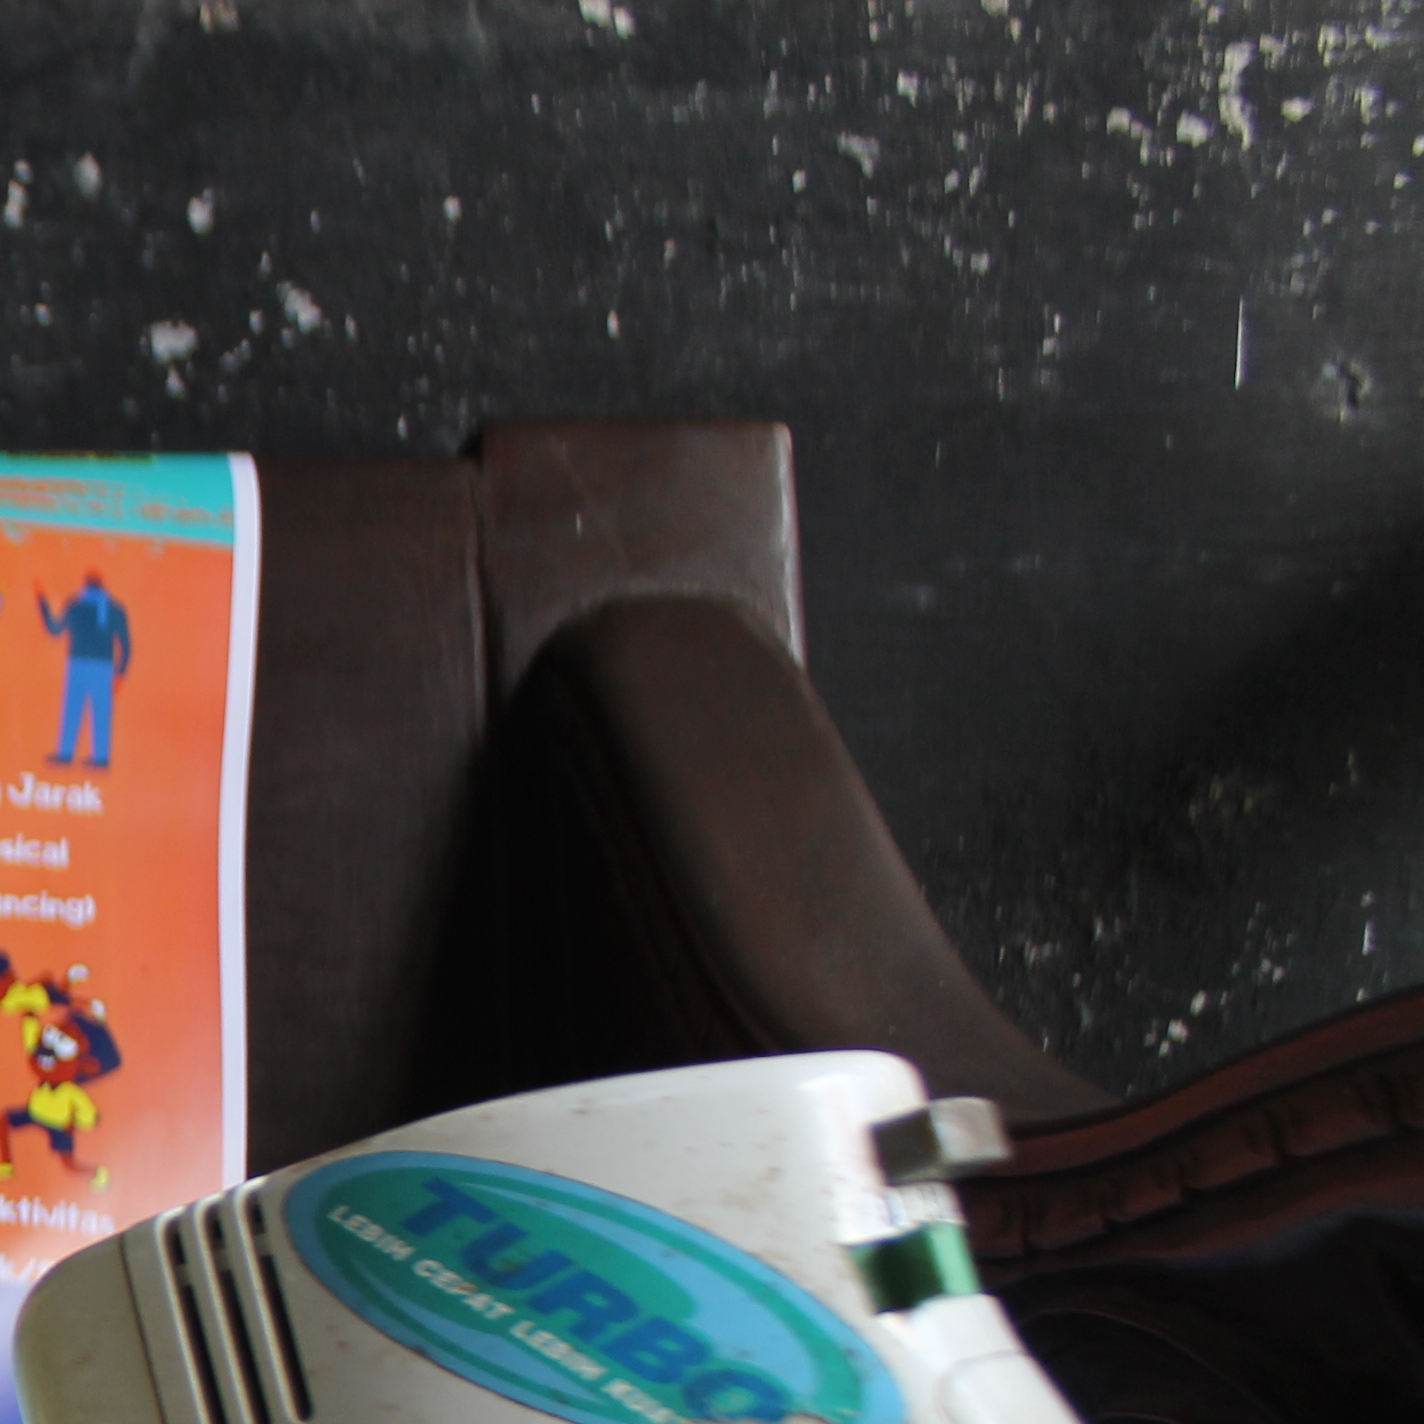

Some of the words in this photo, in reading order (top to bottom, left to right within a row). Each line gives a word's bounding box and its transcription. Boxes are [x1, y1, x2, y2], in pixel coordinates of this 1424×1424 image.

[6, 770, 104, 816] Jarak
[326, 1205, 416, 1262] LEBIH
[412, 1259, 516, 1320] CEPAT
[399, 1176, 792, 1424] TURBO
